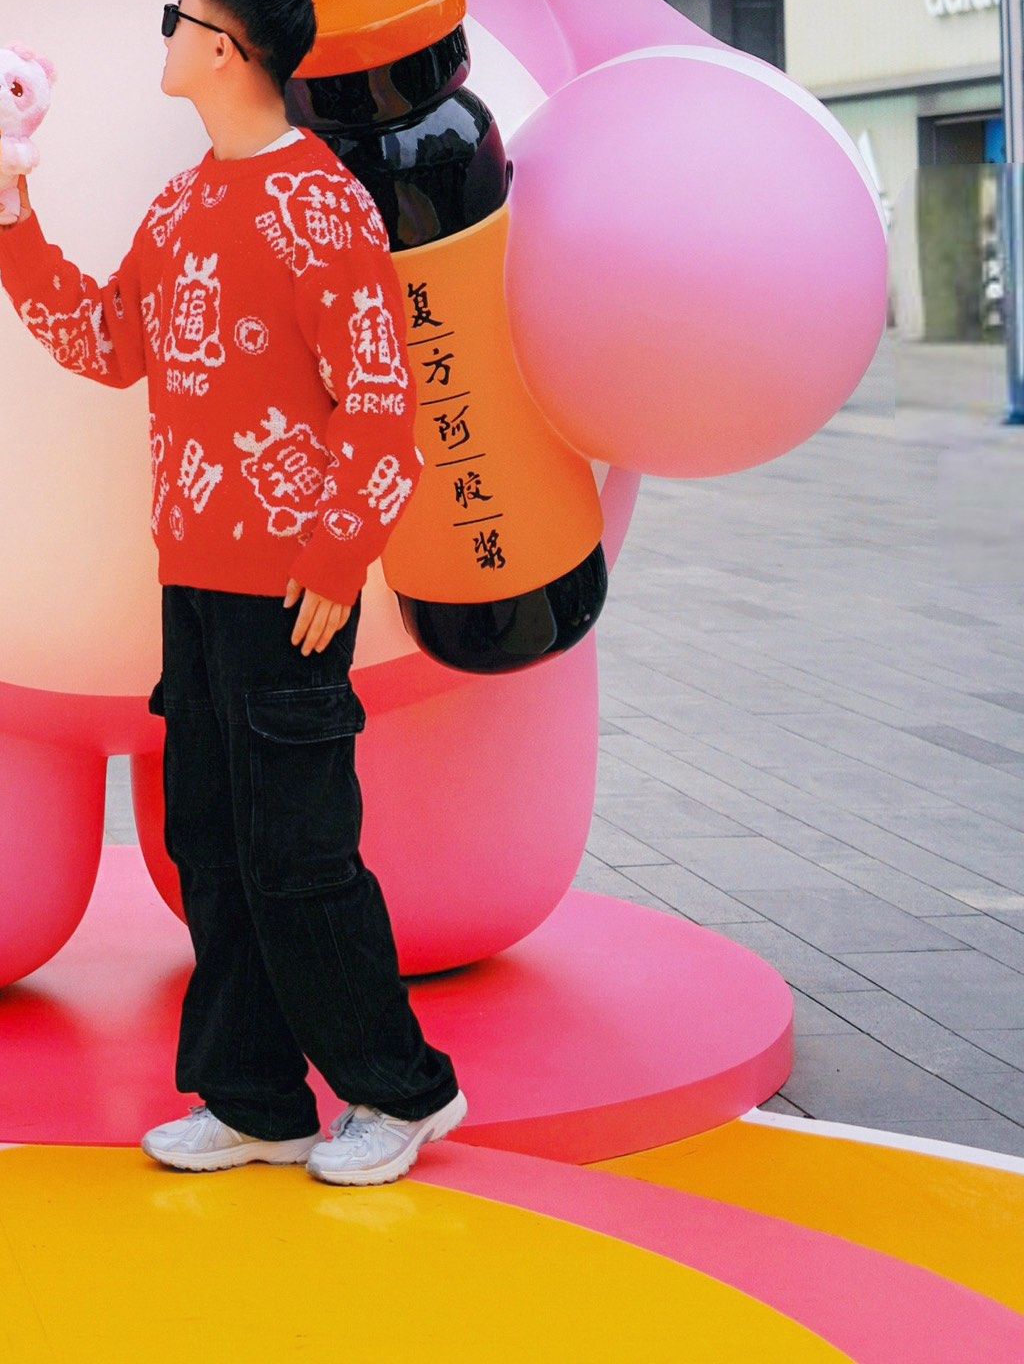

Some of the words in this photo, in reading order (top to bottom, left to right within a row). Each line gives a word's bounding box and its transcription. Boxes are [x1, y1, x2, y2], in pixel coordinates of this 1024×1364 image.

[175, 288, 207, 341] 福
[166, 368, 210, 396] BRMG
[345, 393, 406, 415] BRMG
[407, 282, 506, 571] 复方阿胶浆
